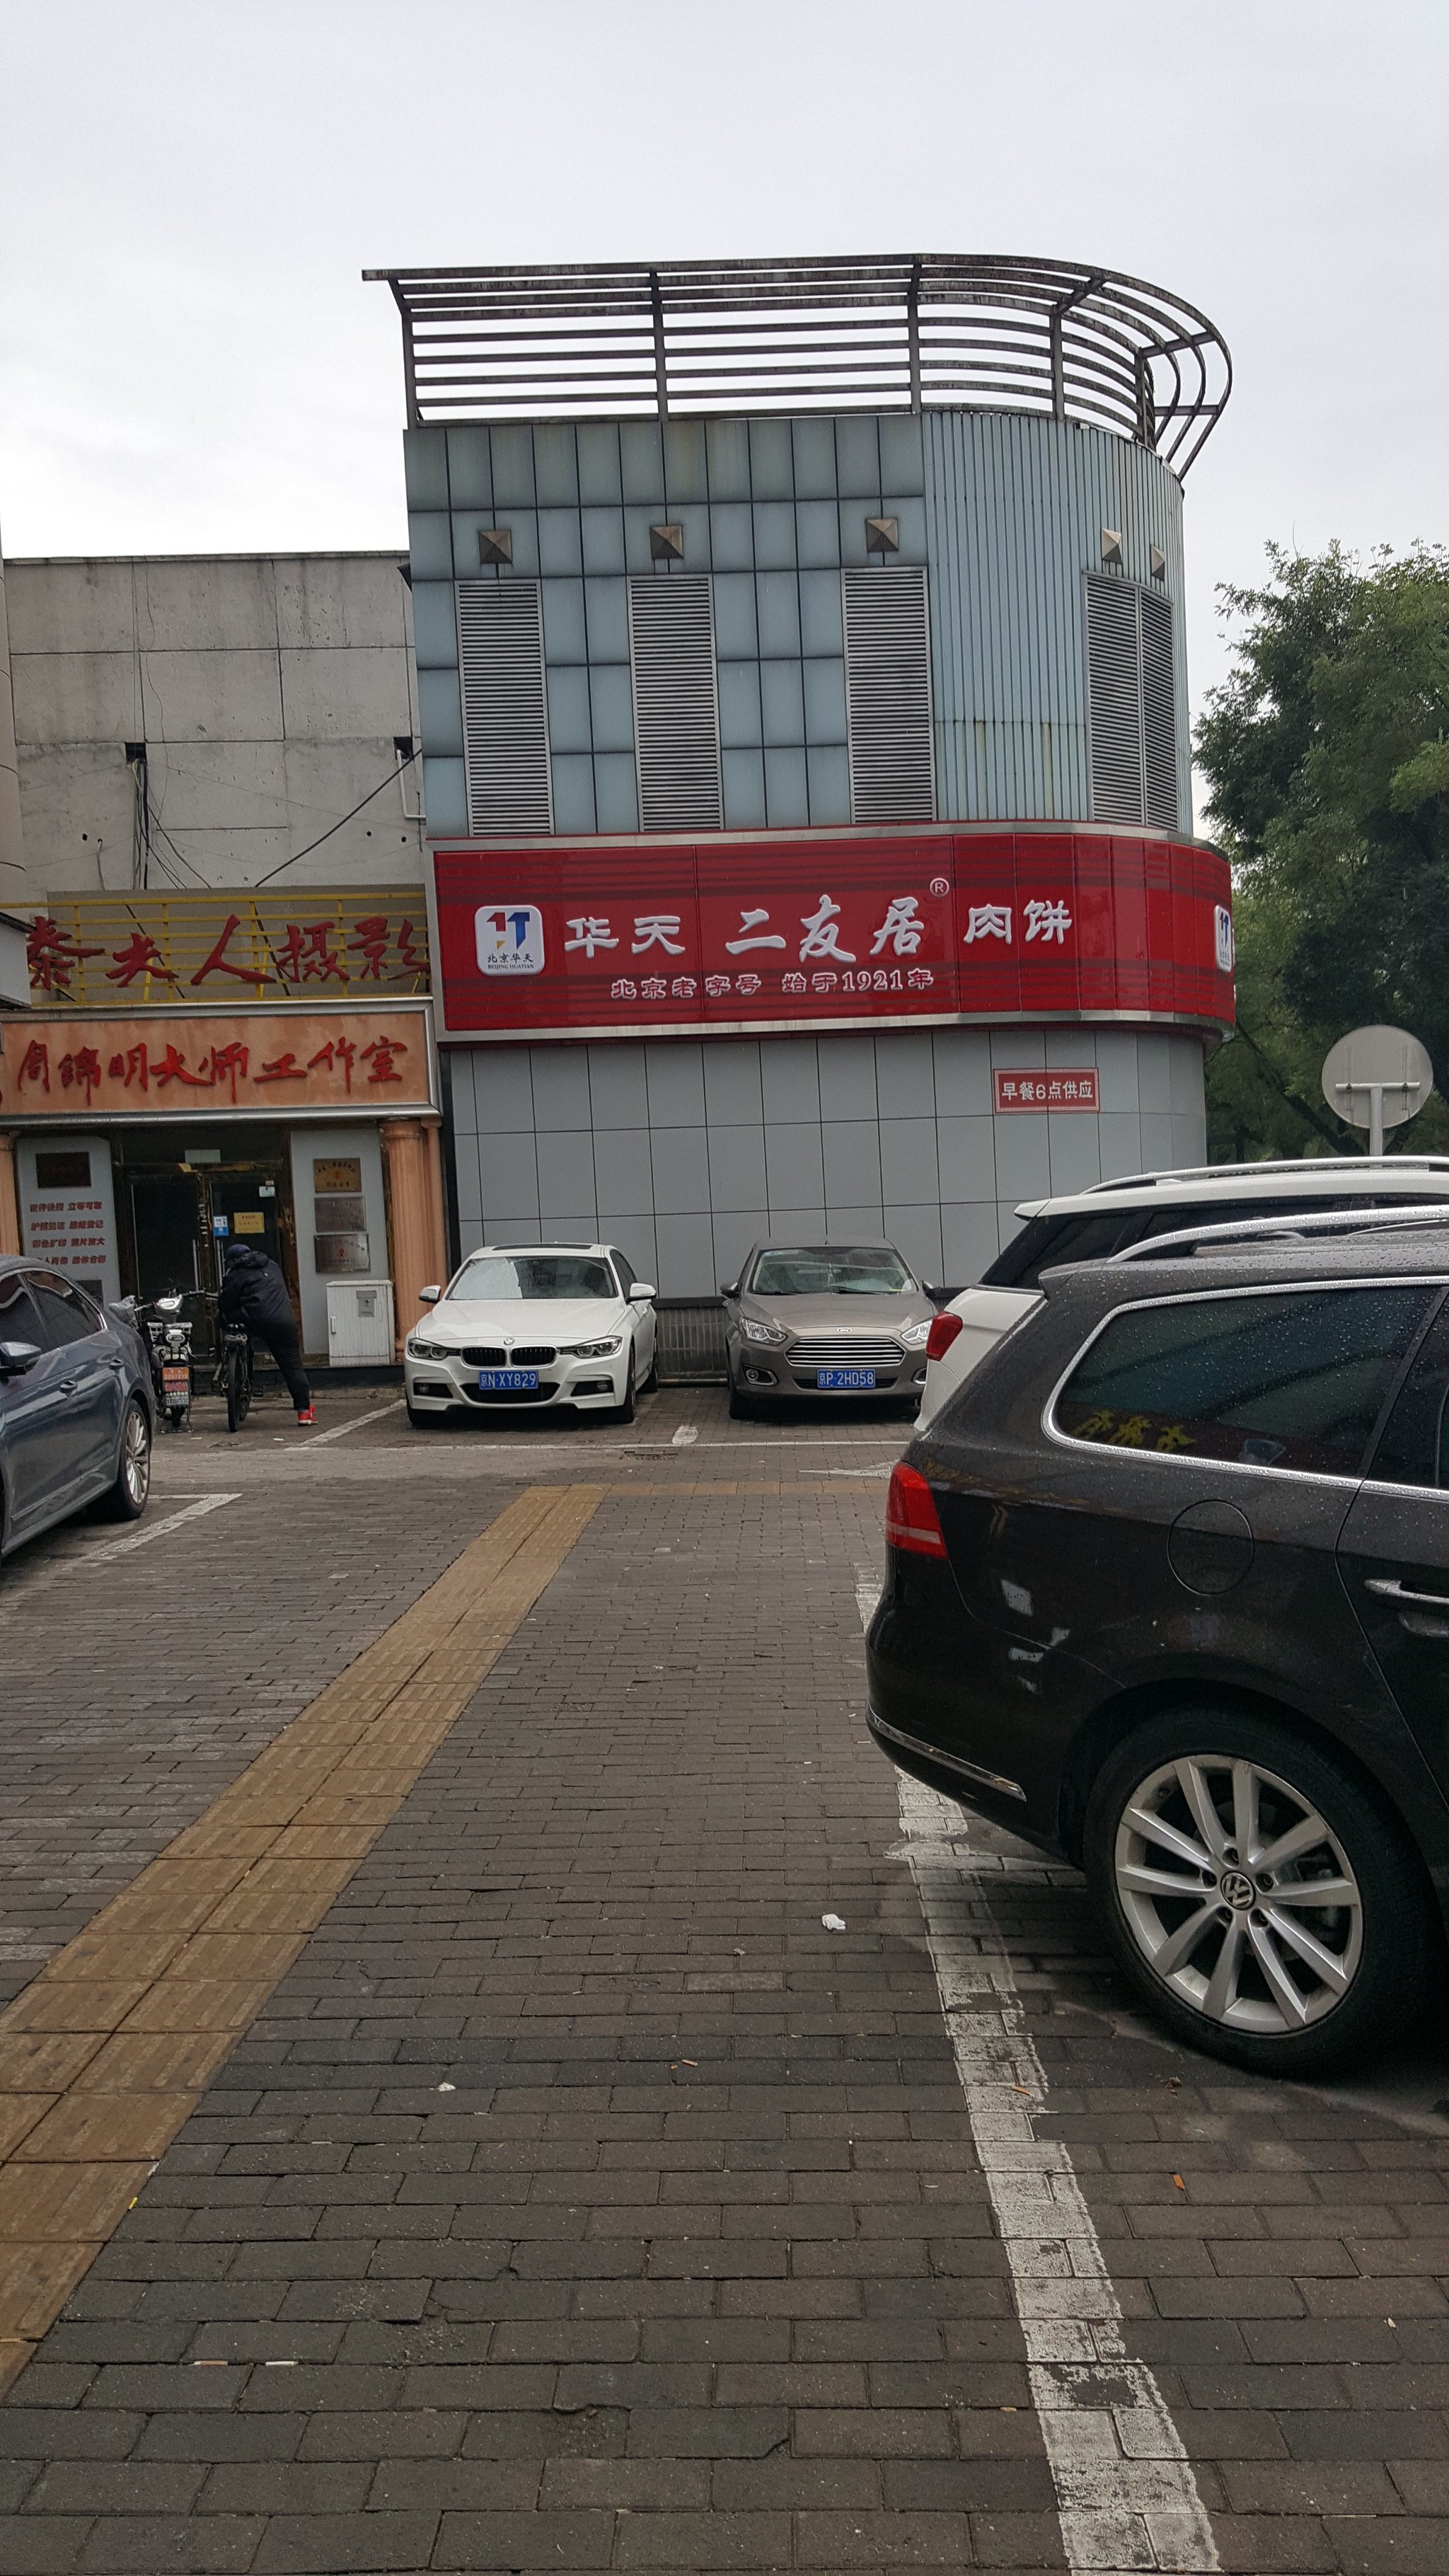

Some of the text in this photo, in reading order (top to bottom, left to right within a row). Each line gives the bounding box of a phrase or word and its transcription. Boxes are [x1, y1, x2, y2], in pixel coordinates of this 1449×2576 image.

[565, 894, 1073, 963] 华天 二友居 肉饼
[487, 952, 533, 963] 北京华天
[611, 968, 934, 1000] 北京老字号 始于1921年
[1002, 1080, 1093, 1100] 早餐6点供应
